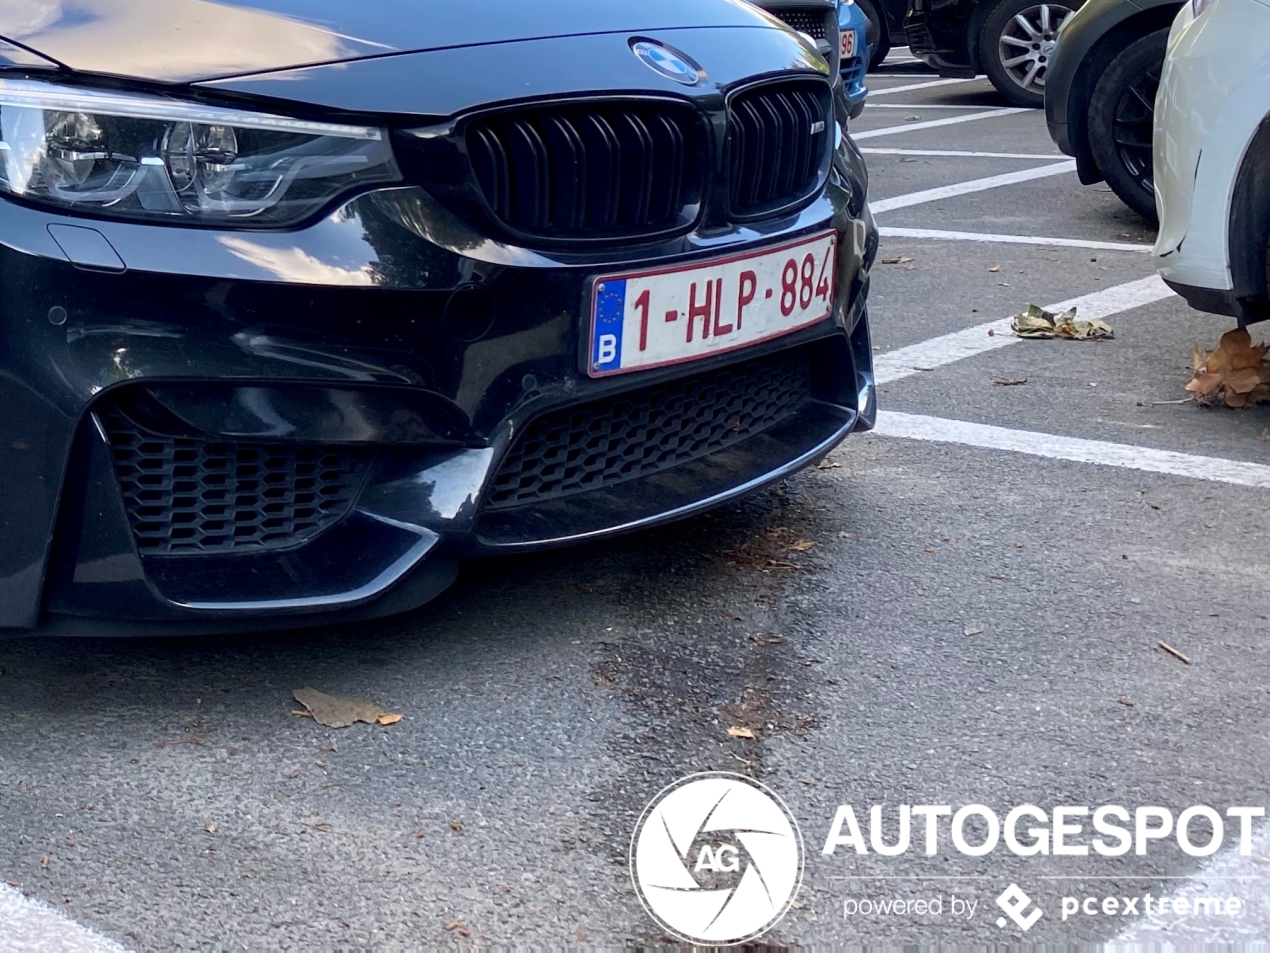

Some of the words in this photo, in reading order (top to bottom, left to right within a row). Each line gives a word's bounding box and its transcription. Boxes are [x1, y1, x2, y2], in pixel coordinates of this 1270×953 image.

[841, 33, 853, 55] 96
[634, 246, 832, 352] 1-HLP-884
[598, 334, 617, 364] B
